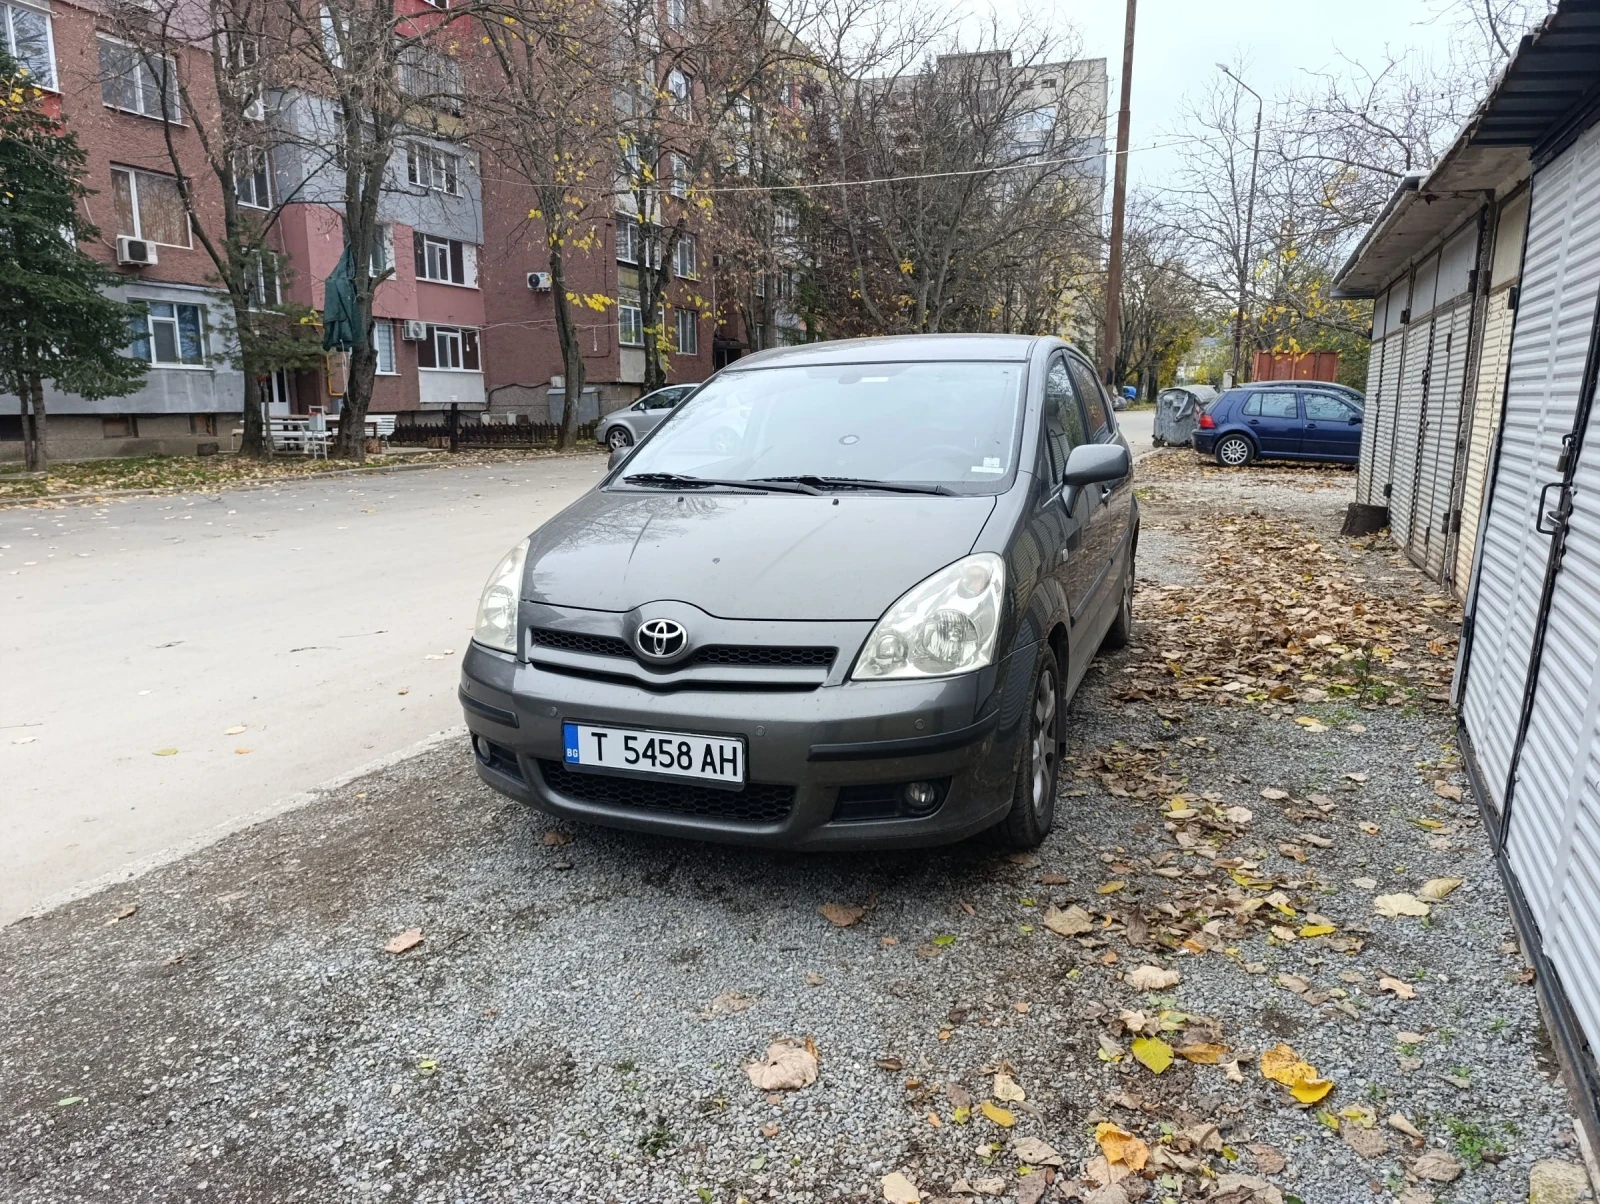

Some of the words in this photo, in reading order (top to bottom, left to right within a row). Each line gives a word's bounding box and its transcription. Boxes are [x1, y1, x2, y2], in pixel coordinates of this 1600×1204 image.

[566, 749, 579, 758] BG
[591, 732, 608, 761] T
[624, 735, 692, 771] 5458
[700, 743, 737, 777] AH
